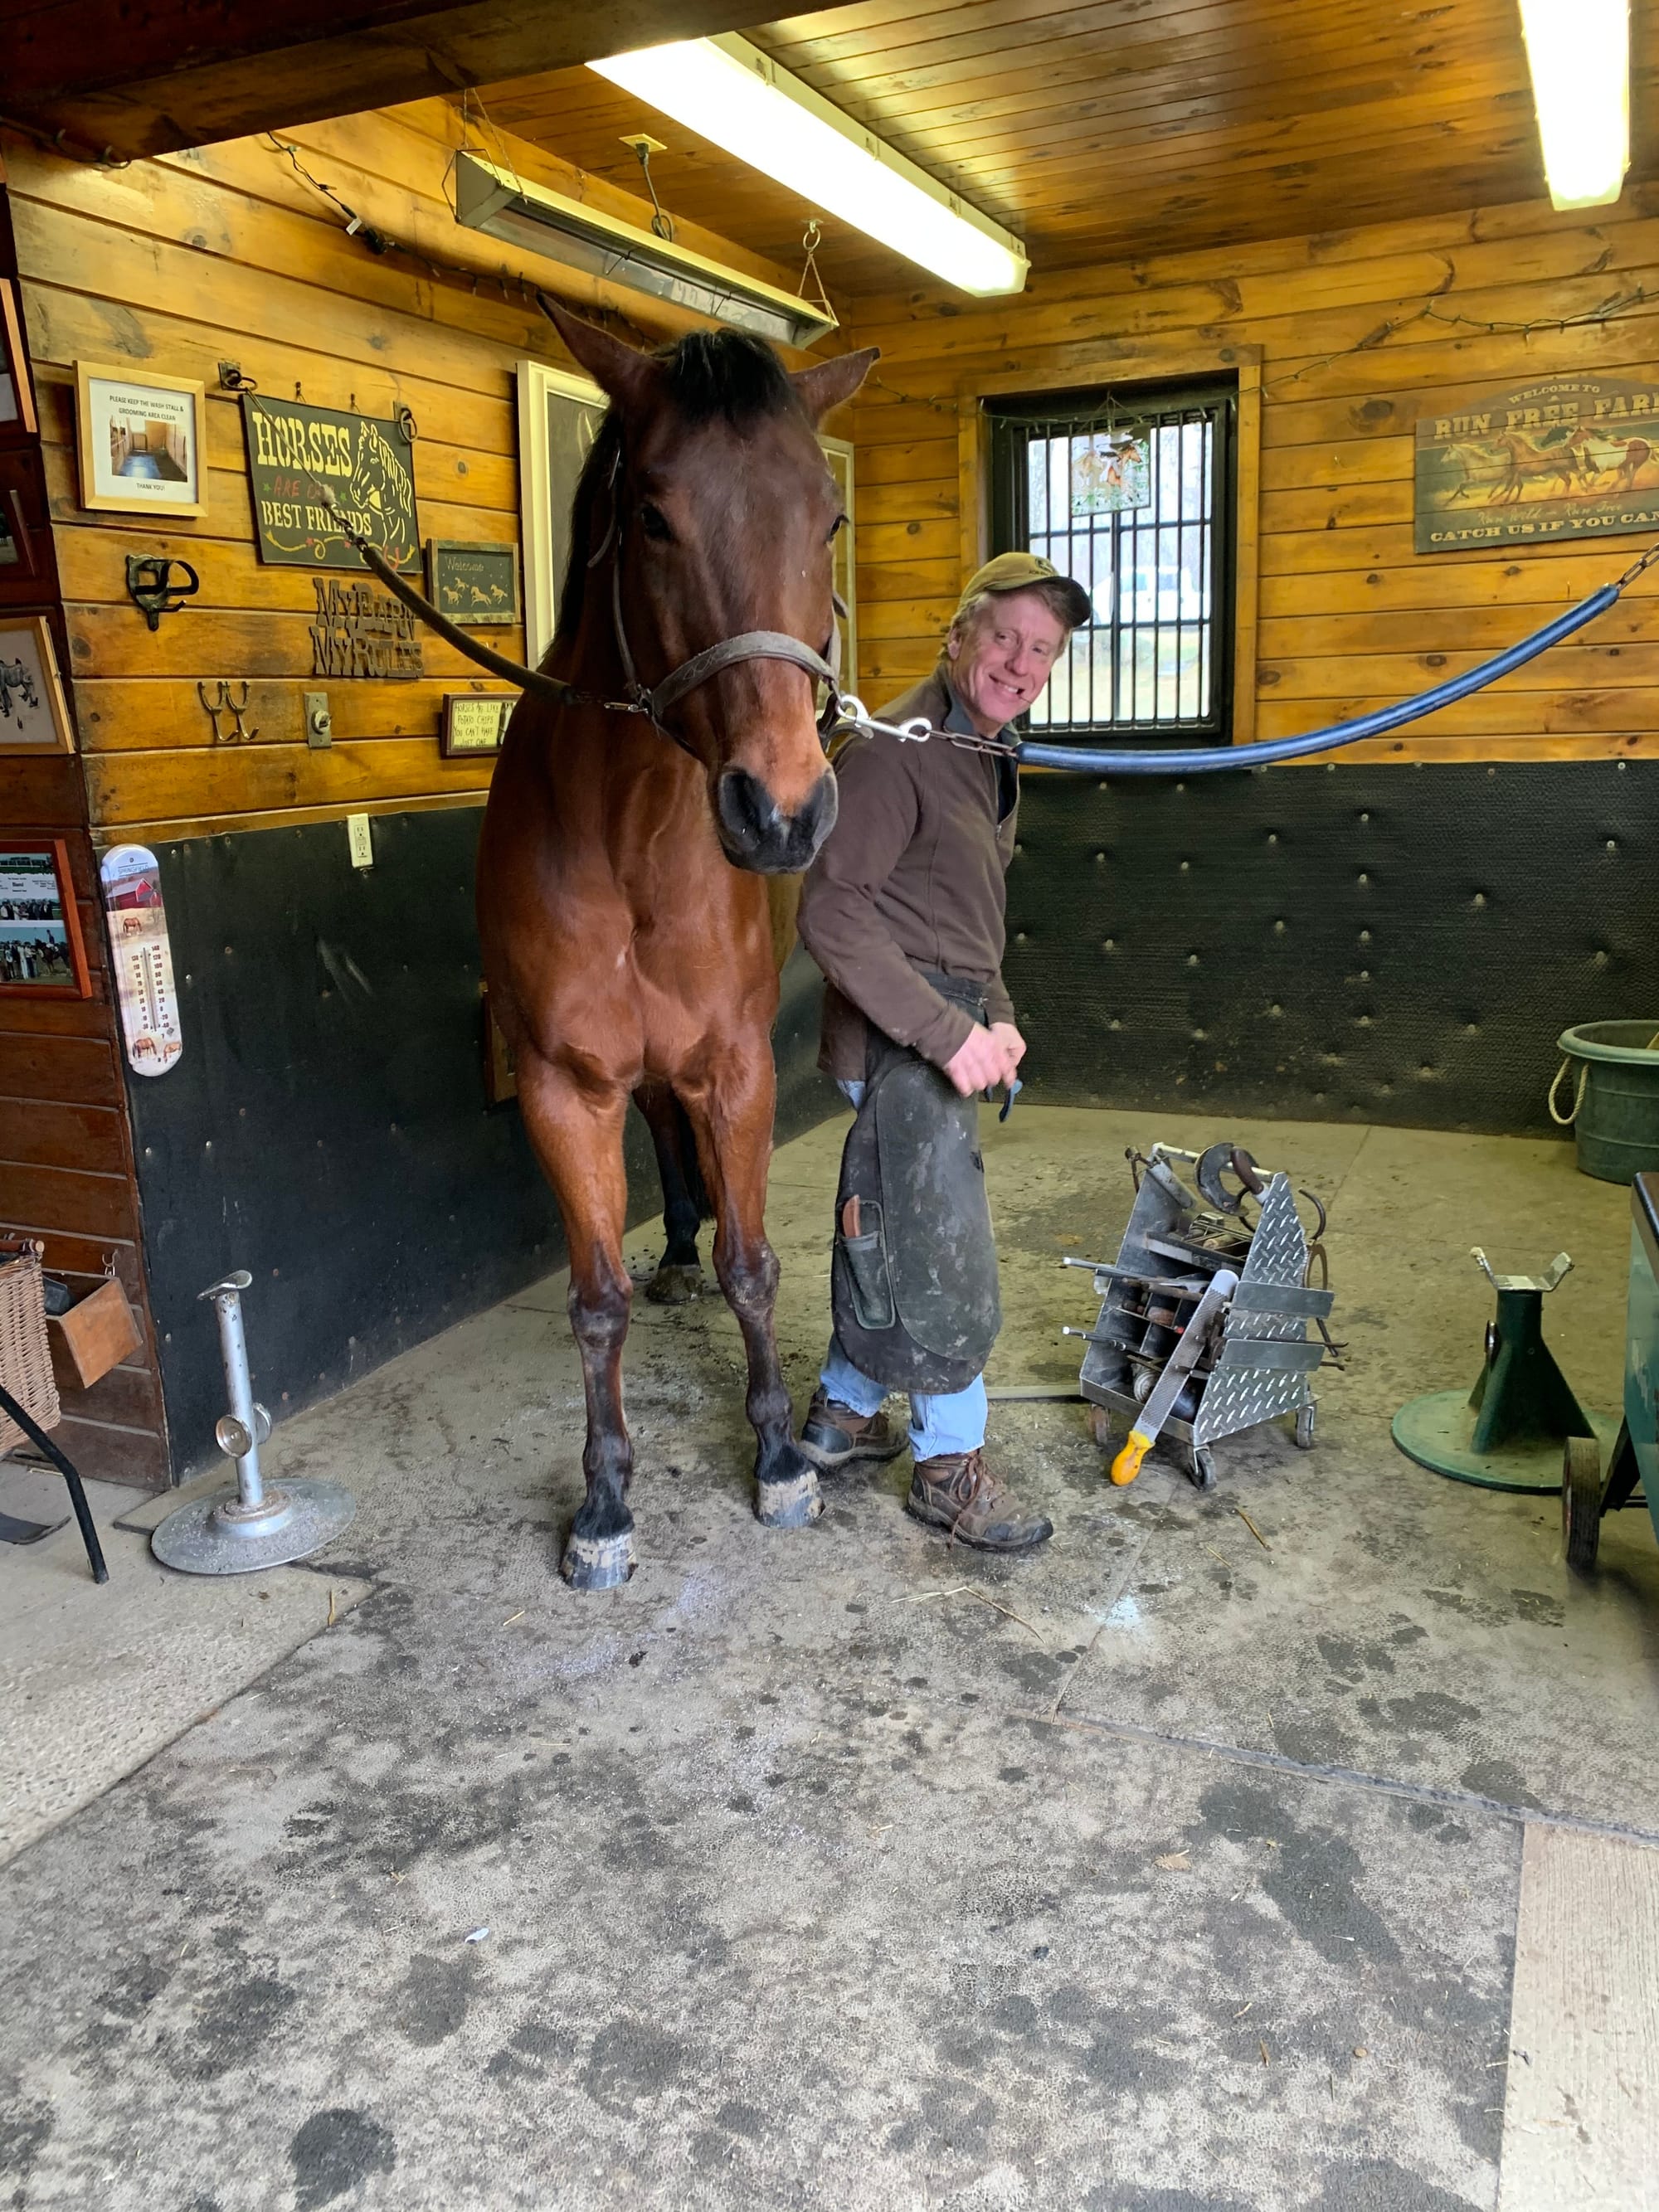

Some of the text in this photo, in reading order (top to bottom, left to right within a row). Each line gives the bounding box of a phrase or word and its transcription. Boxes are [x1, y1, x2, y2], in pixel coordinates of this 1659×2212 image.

[109, 395, 127, 404] PLEASE
[1508, 384, 1601, 405] WELCOME TO
[119, 407, 147, 417] GROOMING
[1434, 413, 1491, 440] RUN
[1506, 402, 1579, 430] FREE
[252, 411, 353, 478] HORSES
[274, 474, 300, 498] ARE
[260, 500, 372, 537] BEST FRIENDS
[1430, 526, 1501, 542] CATCH
[1506, 523, 1535, 535] US
[1539, 520, 1565, 532] IF
[1569, 515, 1617, 529] YOU
[445, 557, 484, 571] Welcome
[455, 702, 474, 714] HORSES
[487, 702, 499, 713] LIKE
[458, 715, 494, 725] POTATO CHIPS
[453, 725, 494, 737] YOU CAN'T HAVE
[119, 865, 148, 874] SPRINGFIELD
